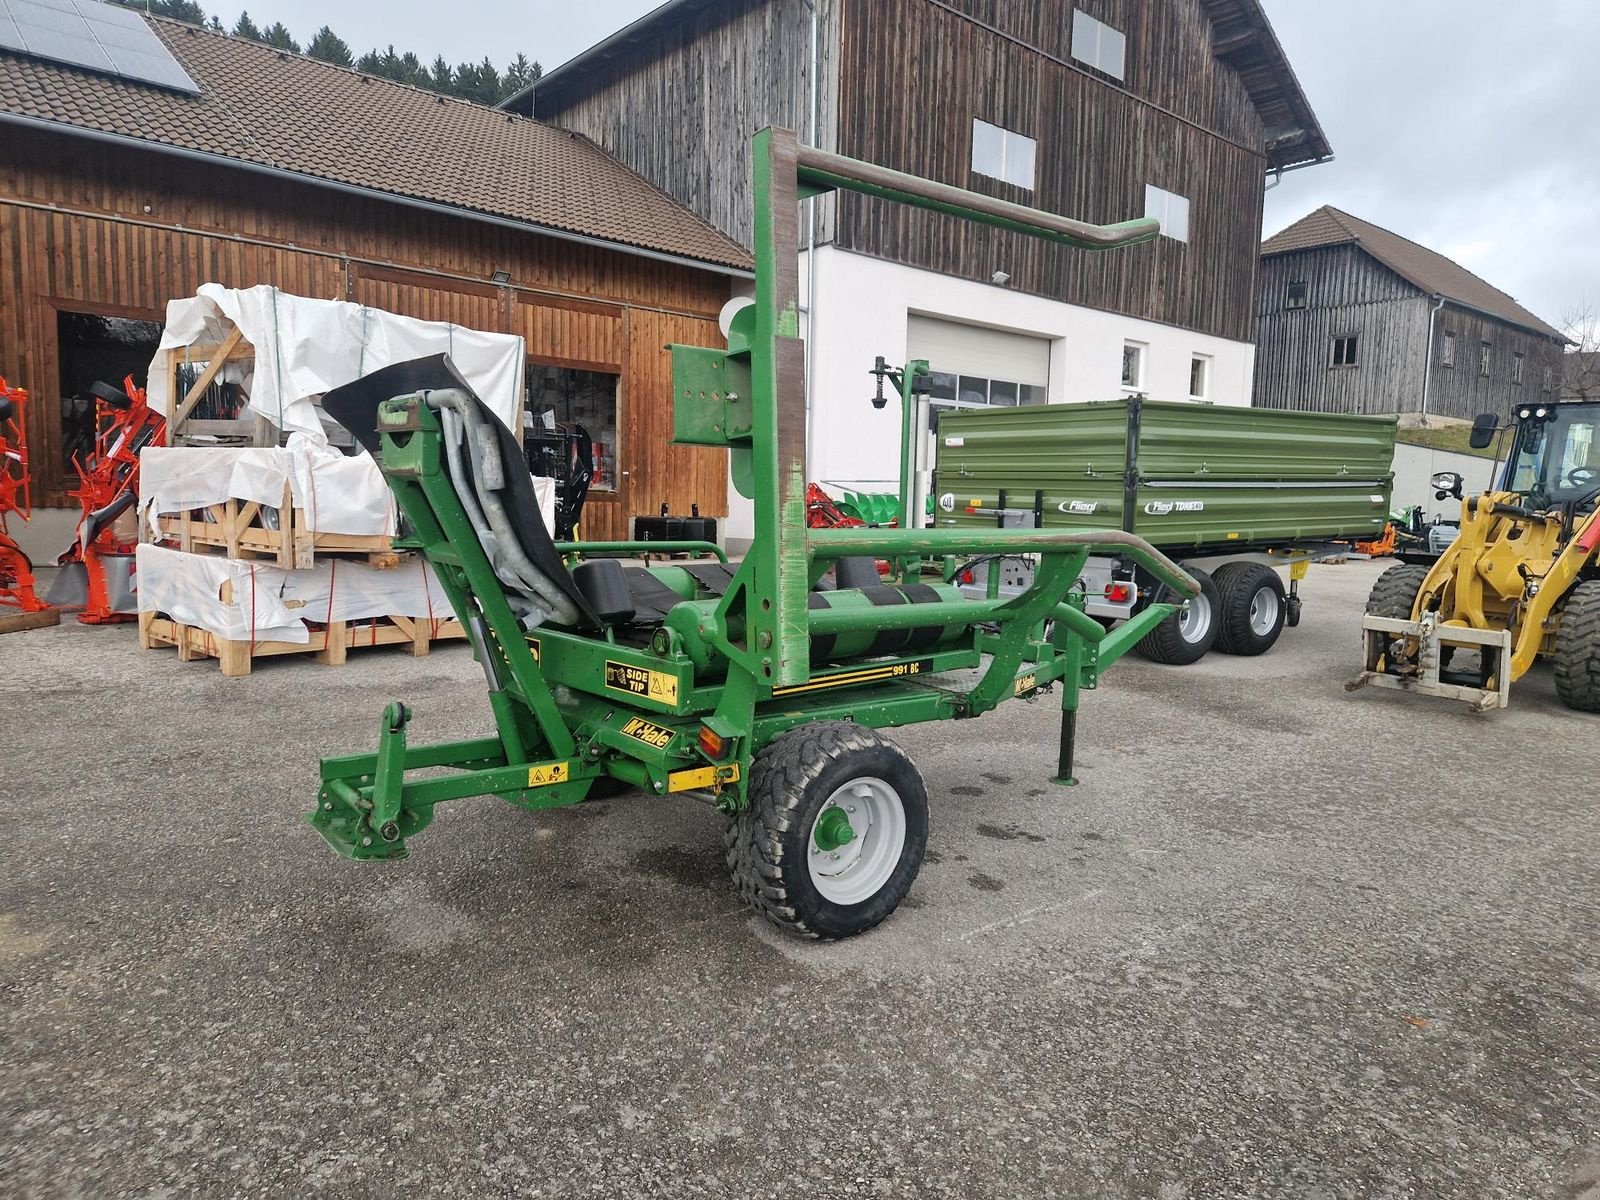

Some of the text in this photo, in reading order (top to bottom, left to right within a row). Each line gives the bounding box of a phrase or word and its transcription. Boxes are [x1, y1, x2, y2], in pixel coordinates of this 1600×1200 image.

[1069, 500, 1097, 513] Fliegl
[626, 668, 648, 683] SIDE
[893, 662, 920, 676] 991 BC
[629, 680, 645, 692] TIP
[623, 719, 670, 746] McHale
